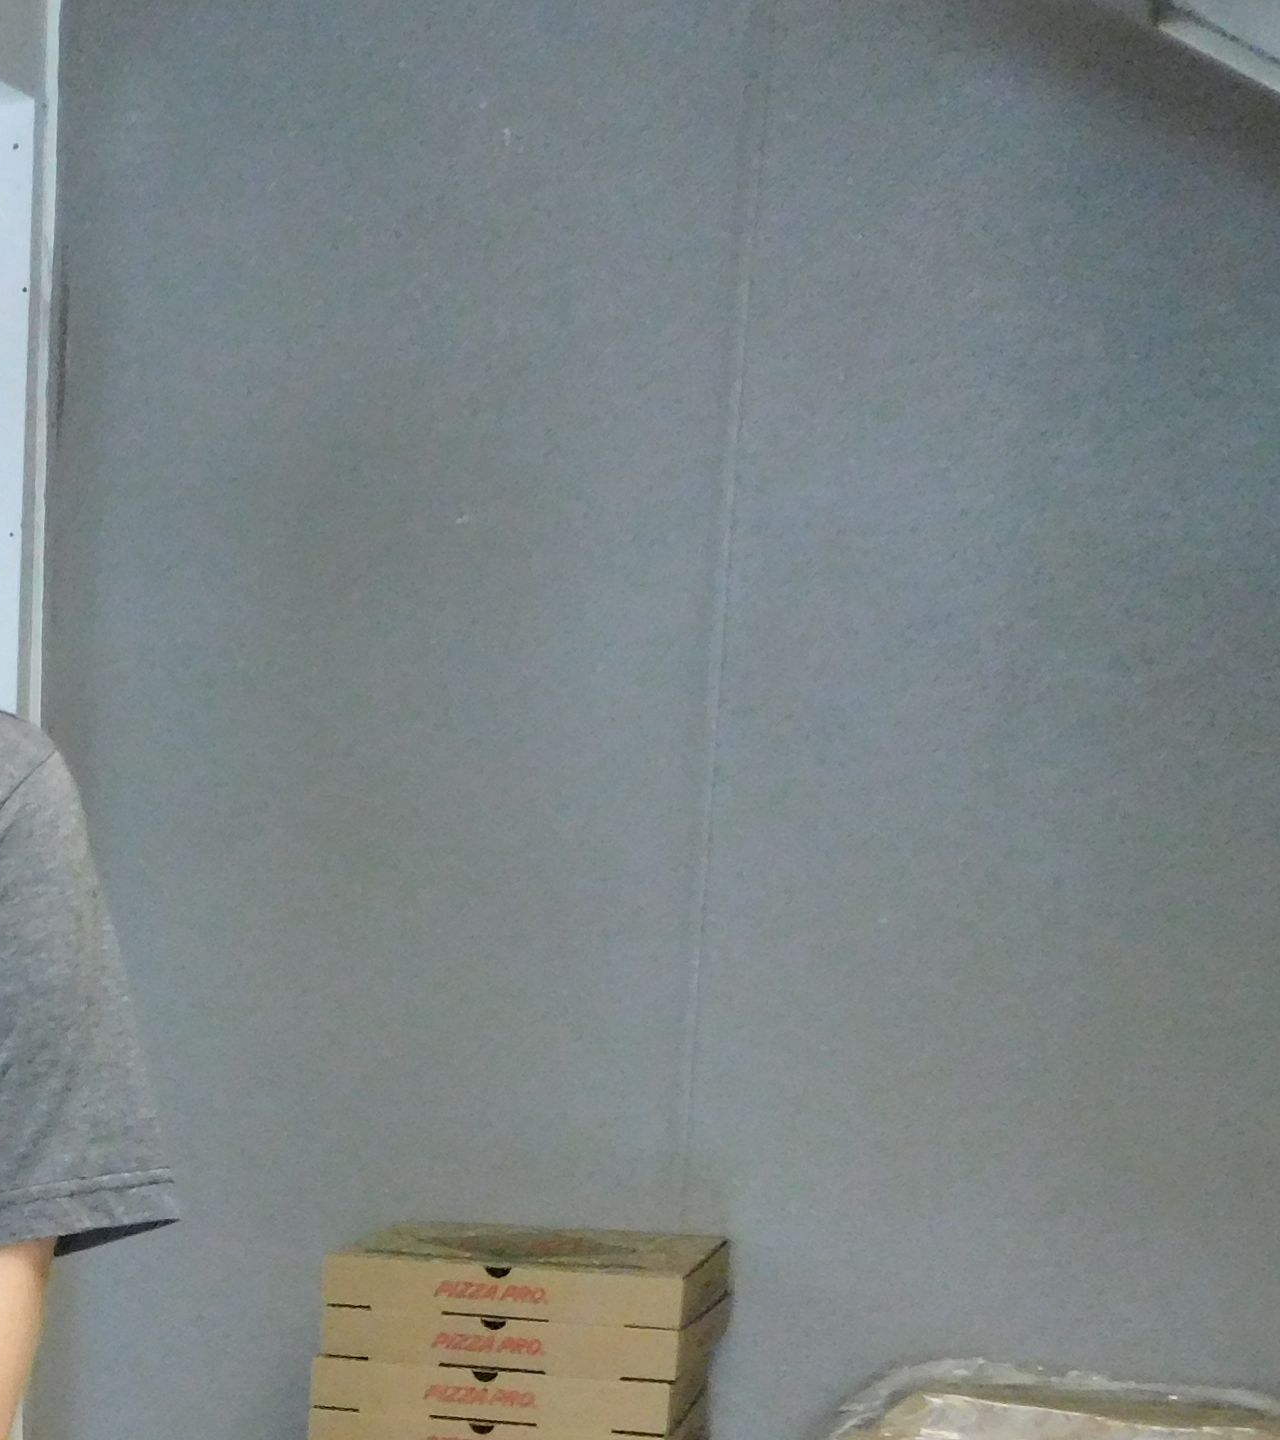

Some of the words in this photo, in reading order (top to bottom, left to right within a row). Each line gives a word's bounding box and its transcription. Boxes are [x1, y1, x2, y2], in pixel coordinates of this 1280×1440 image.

[434, 1280, 499, 1299] PIZZA
[432, 1332, 496, 1352] PIZZA
[424, 1384, 489, 1404] PIZZA
